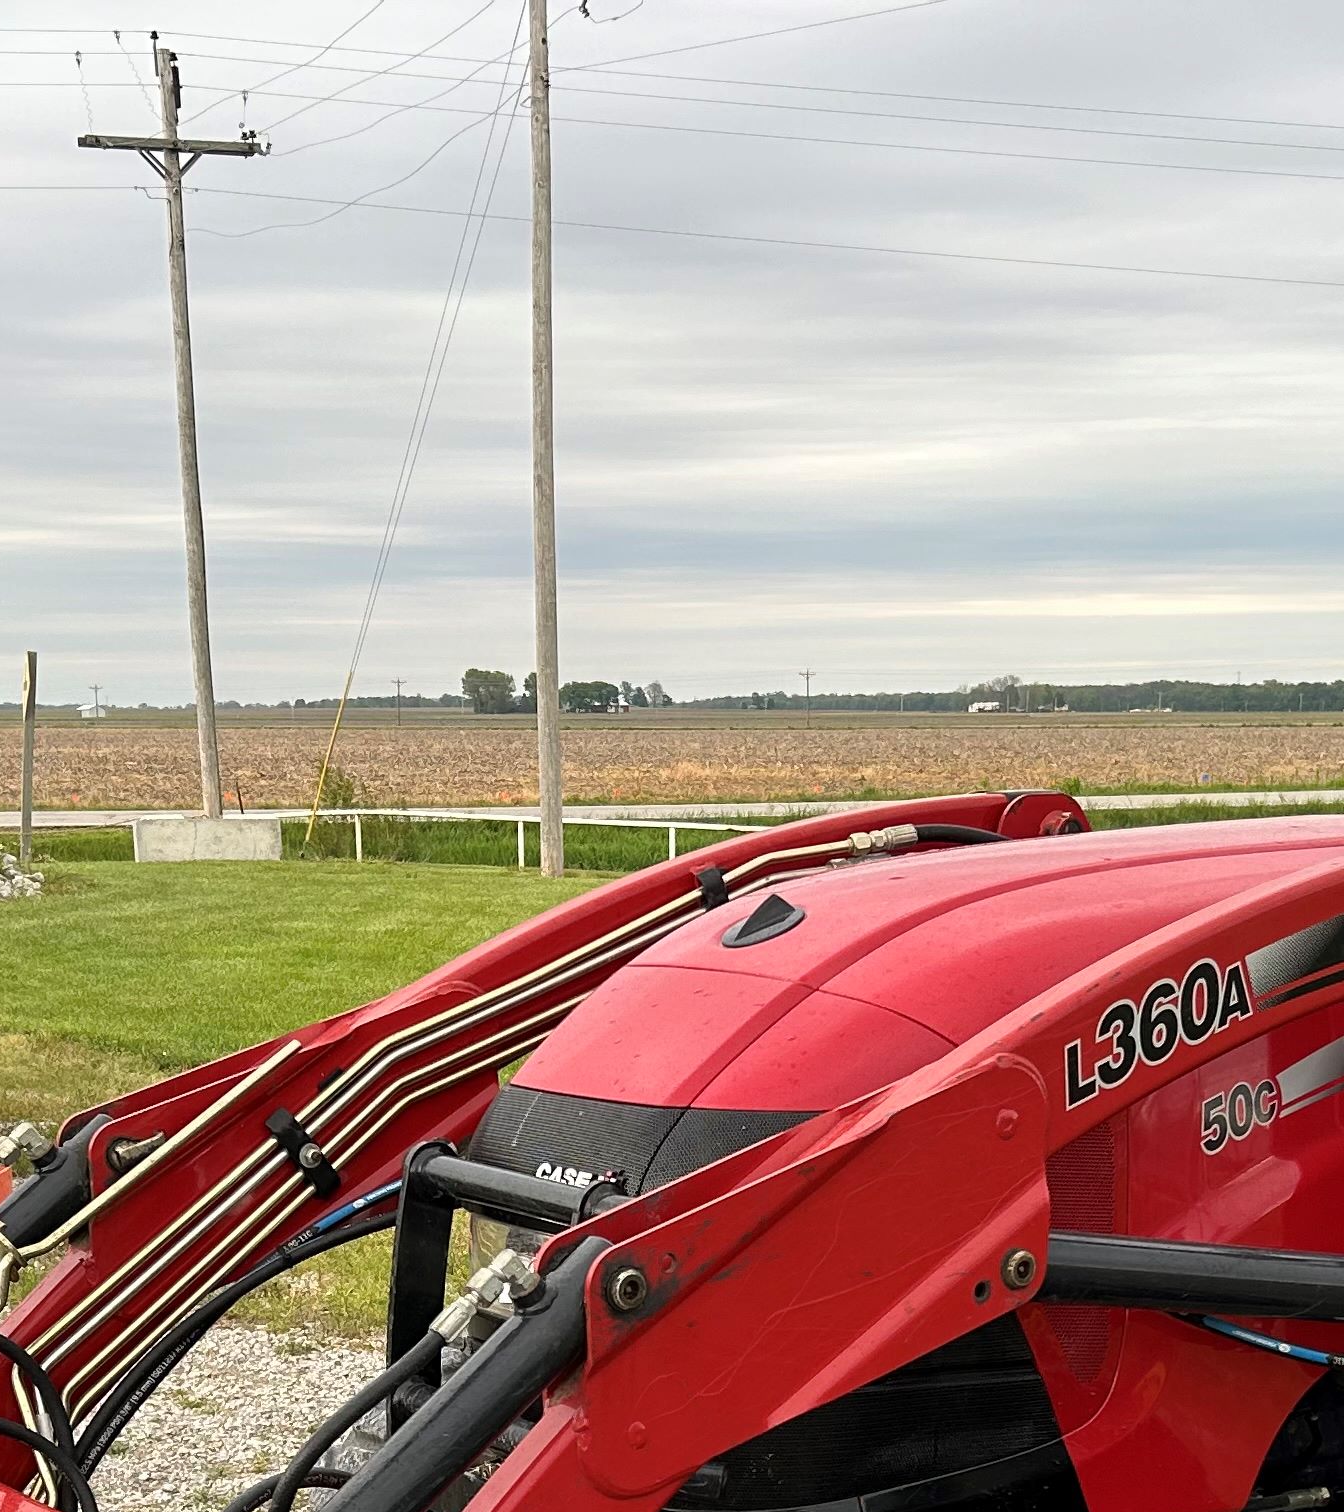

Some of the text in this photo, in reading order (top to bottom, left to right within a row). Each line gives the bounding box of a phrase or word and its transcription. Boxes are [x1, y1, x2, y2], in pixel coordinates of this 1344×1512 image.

[1064, 956, 1253, 1112] L360A
[1199, 1078, 1280, 1156] 50C
[535, 1162, 593, 1189] CASE
